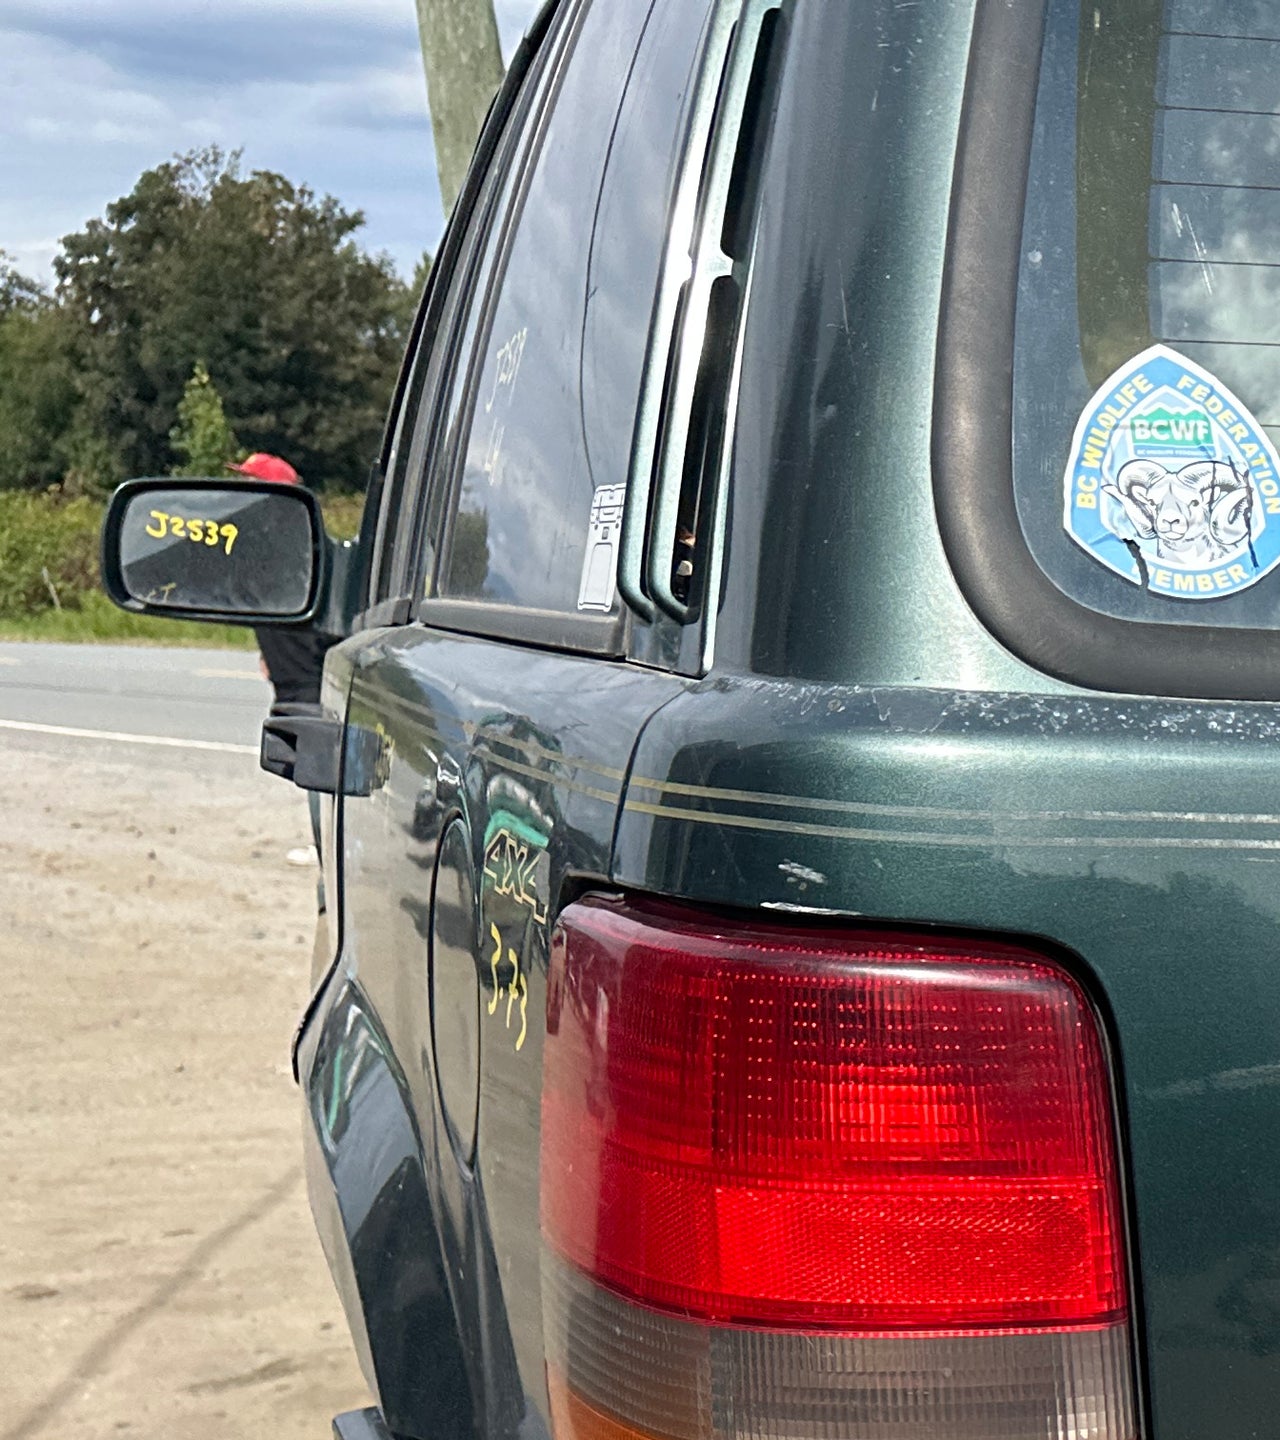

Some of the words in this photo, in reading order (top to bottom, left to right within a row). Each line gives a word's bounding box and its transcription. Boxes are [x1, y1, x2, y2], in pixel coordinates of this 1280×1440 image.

[1081, 373, 1154, 469] WILDLIFE
[1132, 417, 1209, 442] BCWF
[1076, 475, 1099, 510] BC
[145, 510, 239, 556] J2539
[1131, 563, 1249, 593] EMBER
